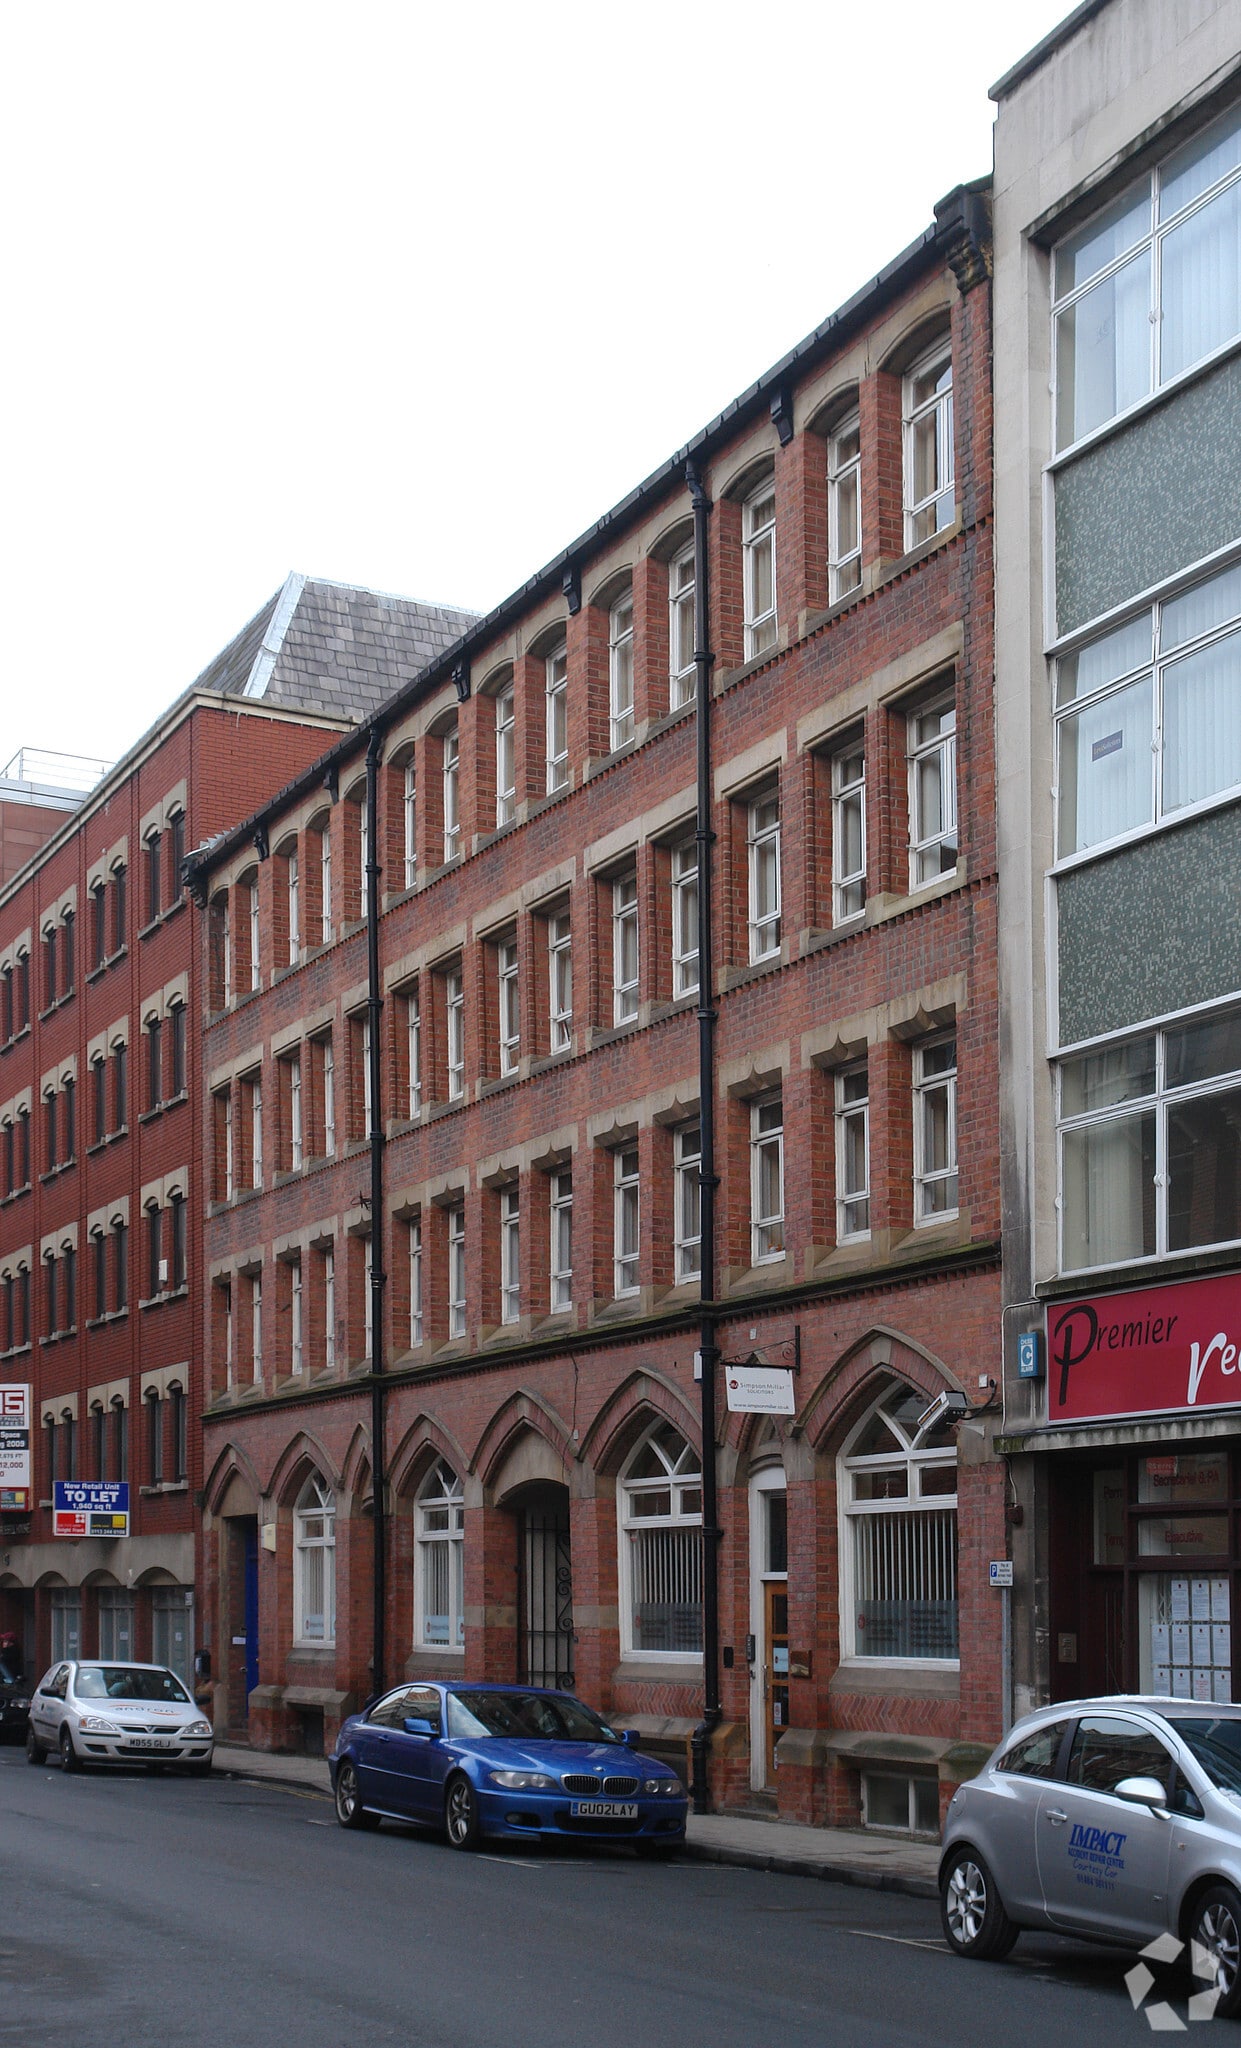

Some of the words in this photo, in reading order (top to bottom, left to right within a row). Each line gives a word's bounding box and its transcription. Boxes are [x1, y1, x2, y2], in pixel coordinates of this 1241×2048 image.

[1054, 1305, 1178, 1406] Premier
[1187, 1332, 1241, 1405] re
[1, 1431, 20, 1439] Space
[64, 1490, 86, 1502] TO
[90, 1491, 119, 1503] LET
[72, 1502, 93, 1510] 1,940
[1069, 1824, 1127, 1857] IMPACT
[1068, 1847, 1089, 1860] ACCIDENT
[1090, 1852, 1106, 1865] REPAIR
[1106, 1856, 1125, 1870] CENTRE
[1073, 1858, 1103, 1878] Courtesy
[1105, 1866, 1118, 1878] Car
